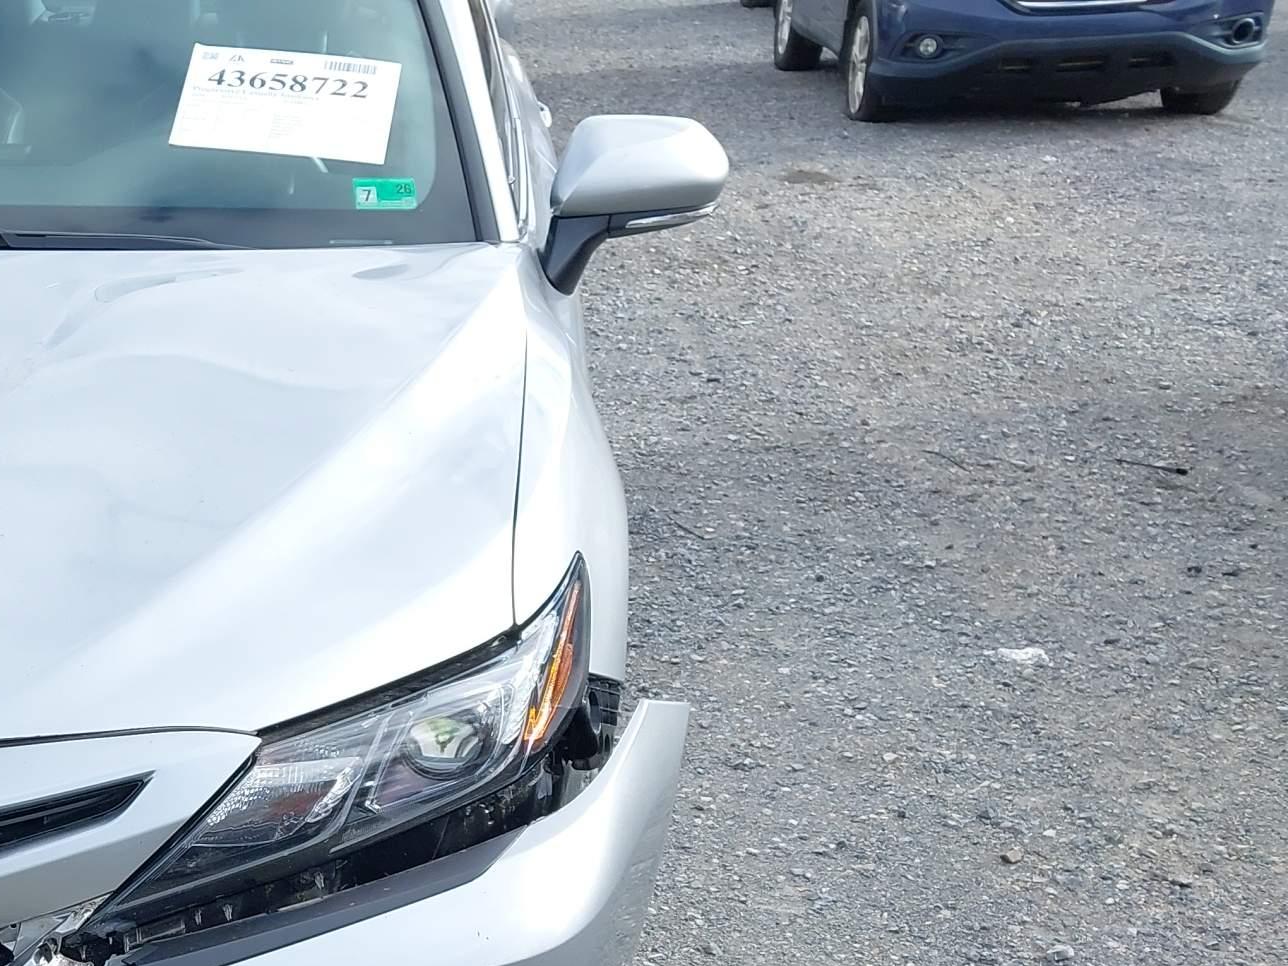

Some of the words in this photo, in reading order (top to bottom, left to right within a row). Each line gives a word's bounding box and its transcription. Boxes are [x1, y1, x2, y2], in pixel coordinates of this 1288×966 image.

[207, 68, 369, 99] 43658722
[395, 183, 412, 194] 26
[361, 189, 372, 202] 7
